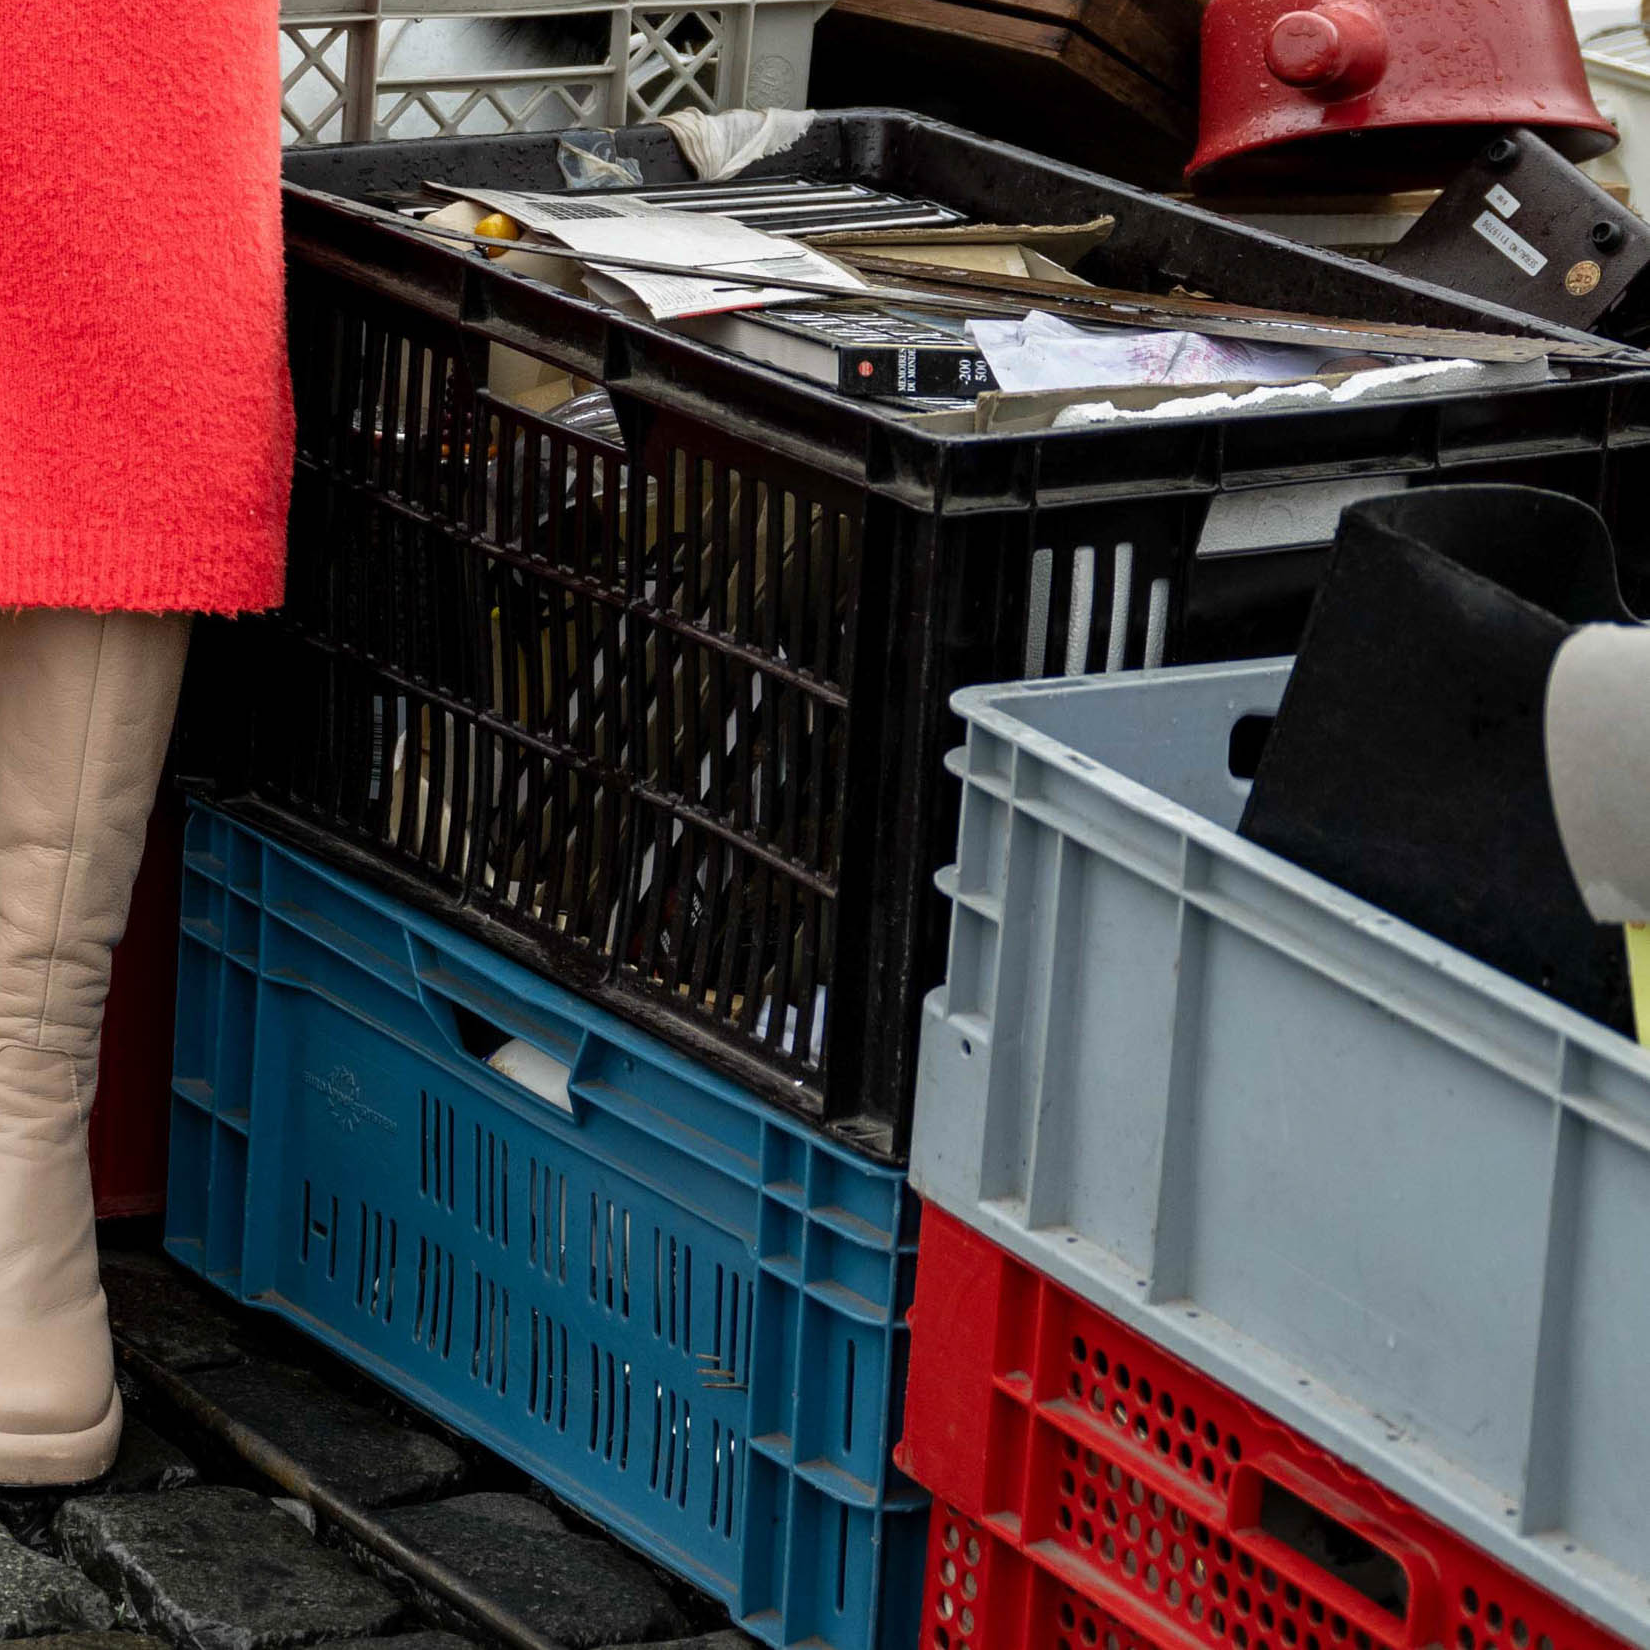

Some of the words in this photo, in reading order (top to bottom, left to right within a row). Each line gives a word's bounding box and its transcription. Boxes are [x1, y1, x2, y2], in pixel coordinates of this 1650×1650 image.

[897, 348, 907, 392] MEMOIRES
[907, 348, 916, 379] MONDE
[959, 359, 971, 385] -200
[975, 360, 987, 382] 500
[907, 380, 916, 392] DU
